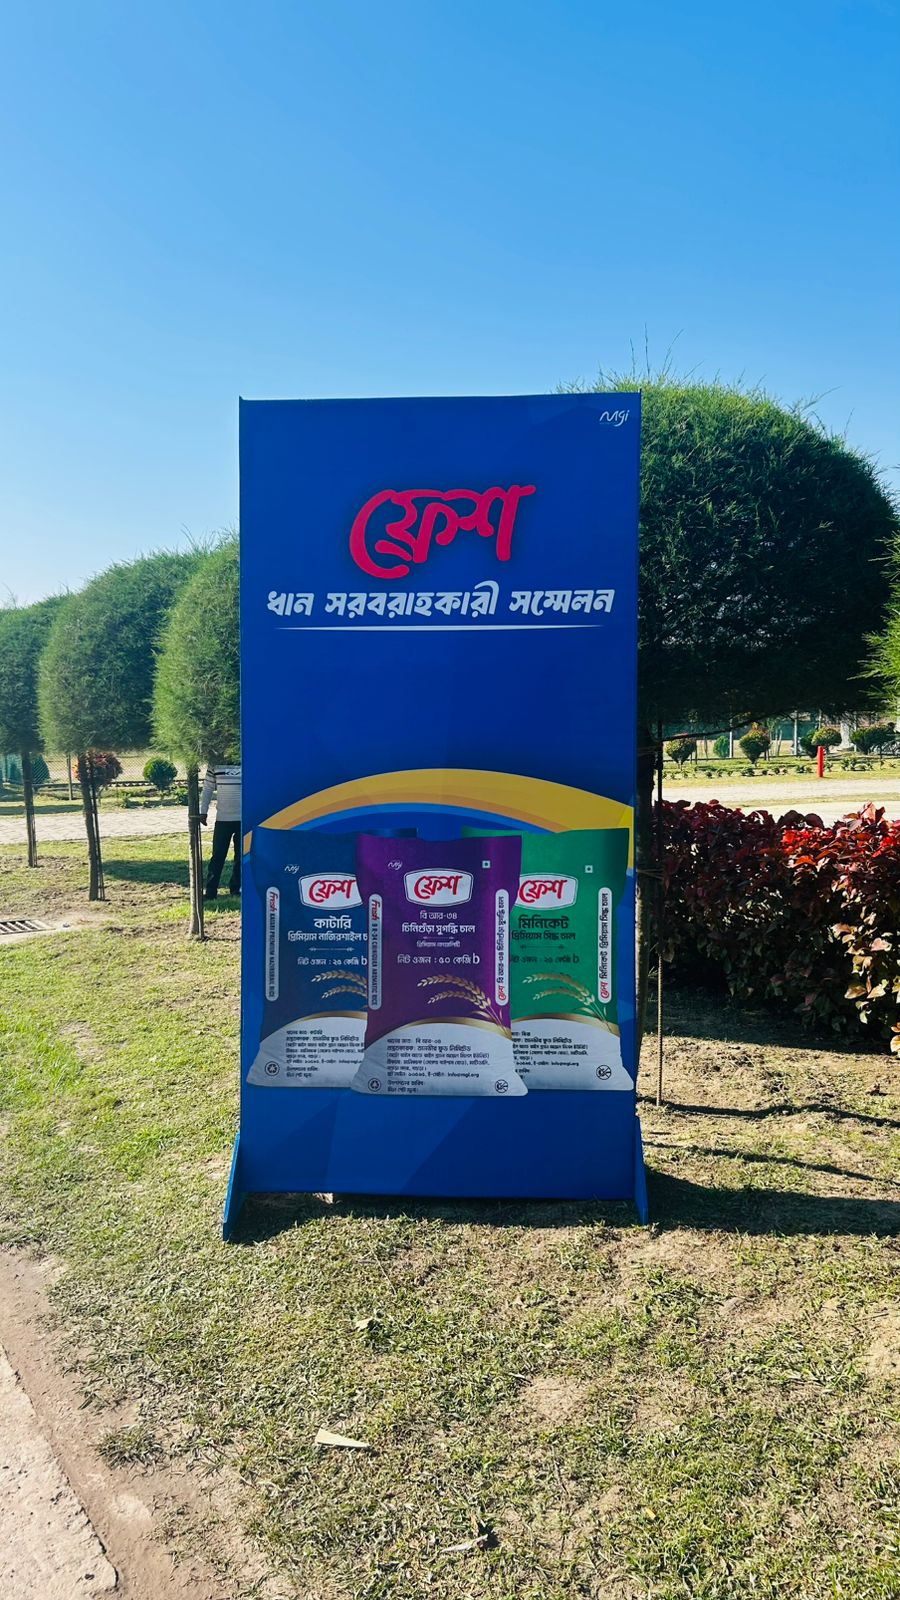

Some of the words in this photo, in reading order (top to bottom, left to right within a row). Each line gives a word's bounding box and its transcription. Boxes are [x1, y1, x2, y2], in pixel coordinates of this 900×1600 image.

[349, 485, 536, 579] ফ্রেশ
[266, 590, 314, 616] ধান
[325, 580, 498, 619] সরবরাহকারী
[509, 589, 615, 616] সম্মেলন
[308, 879, 357, 903] ফ্রেশ
[413, 875, 463, 900] ফ্রেশ
[519, 879, 567, 903] ফ্রেশ
[313, 915, 352, 930] কাটারি
[436, 922, 459, 936] সুগন্ধি
[459, 925, 476, 933] চাল
[518, 914, 569, 929] মিনিকেট
[397, 953, 411, 964] নিট
[412, 956, 431, 964] ওজন
[453, 954, 472, 964] কেজি
